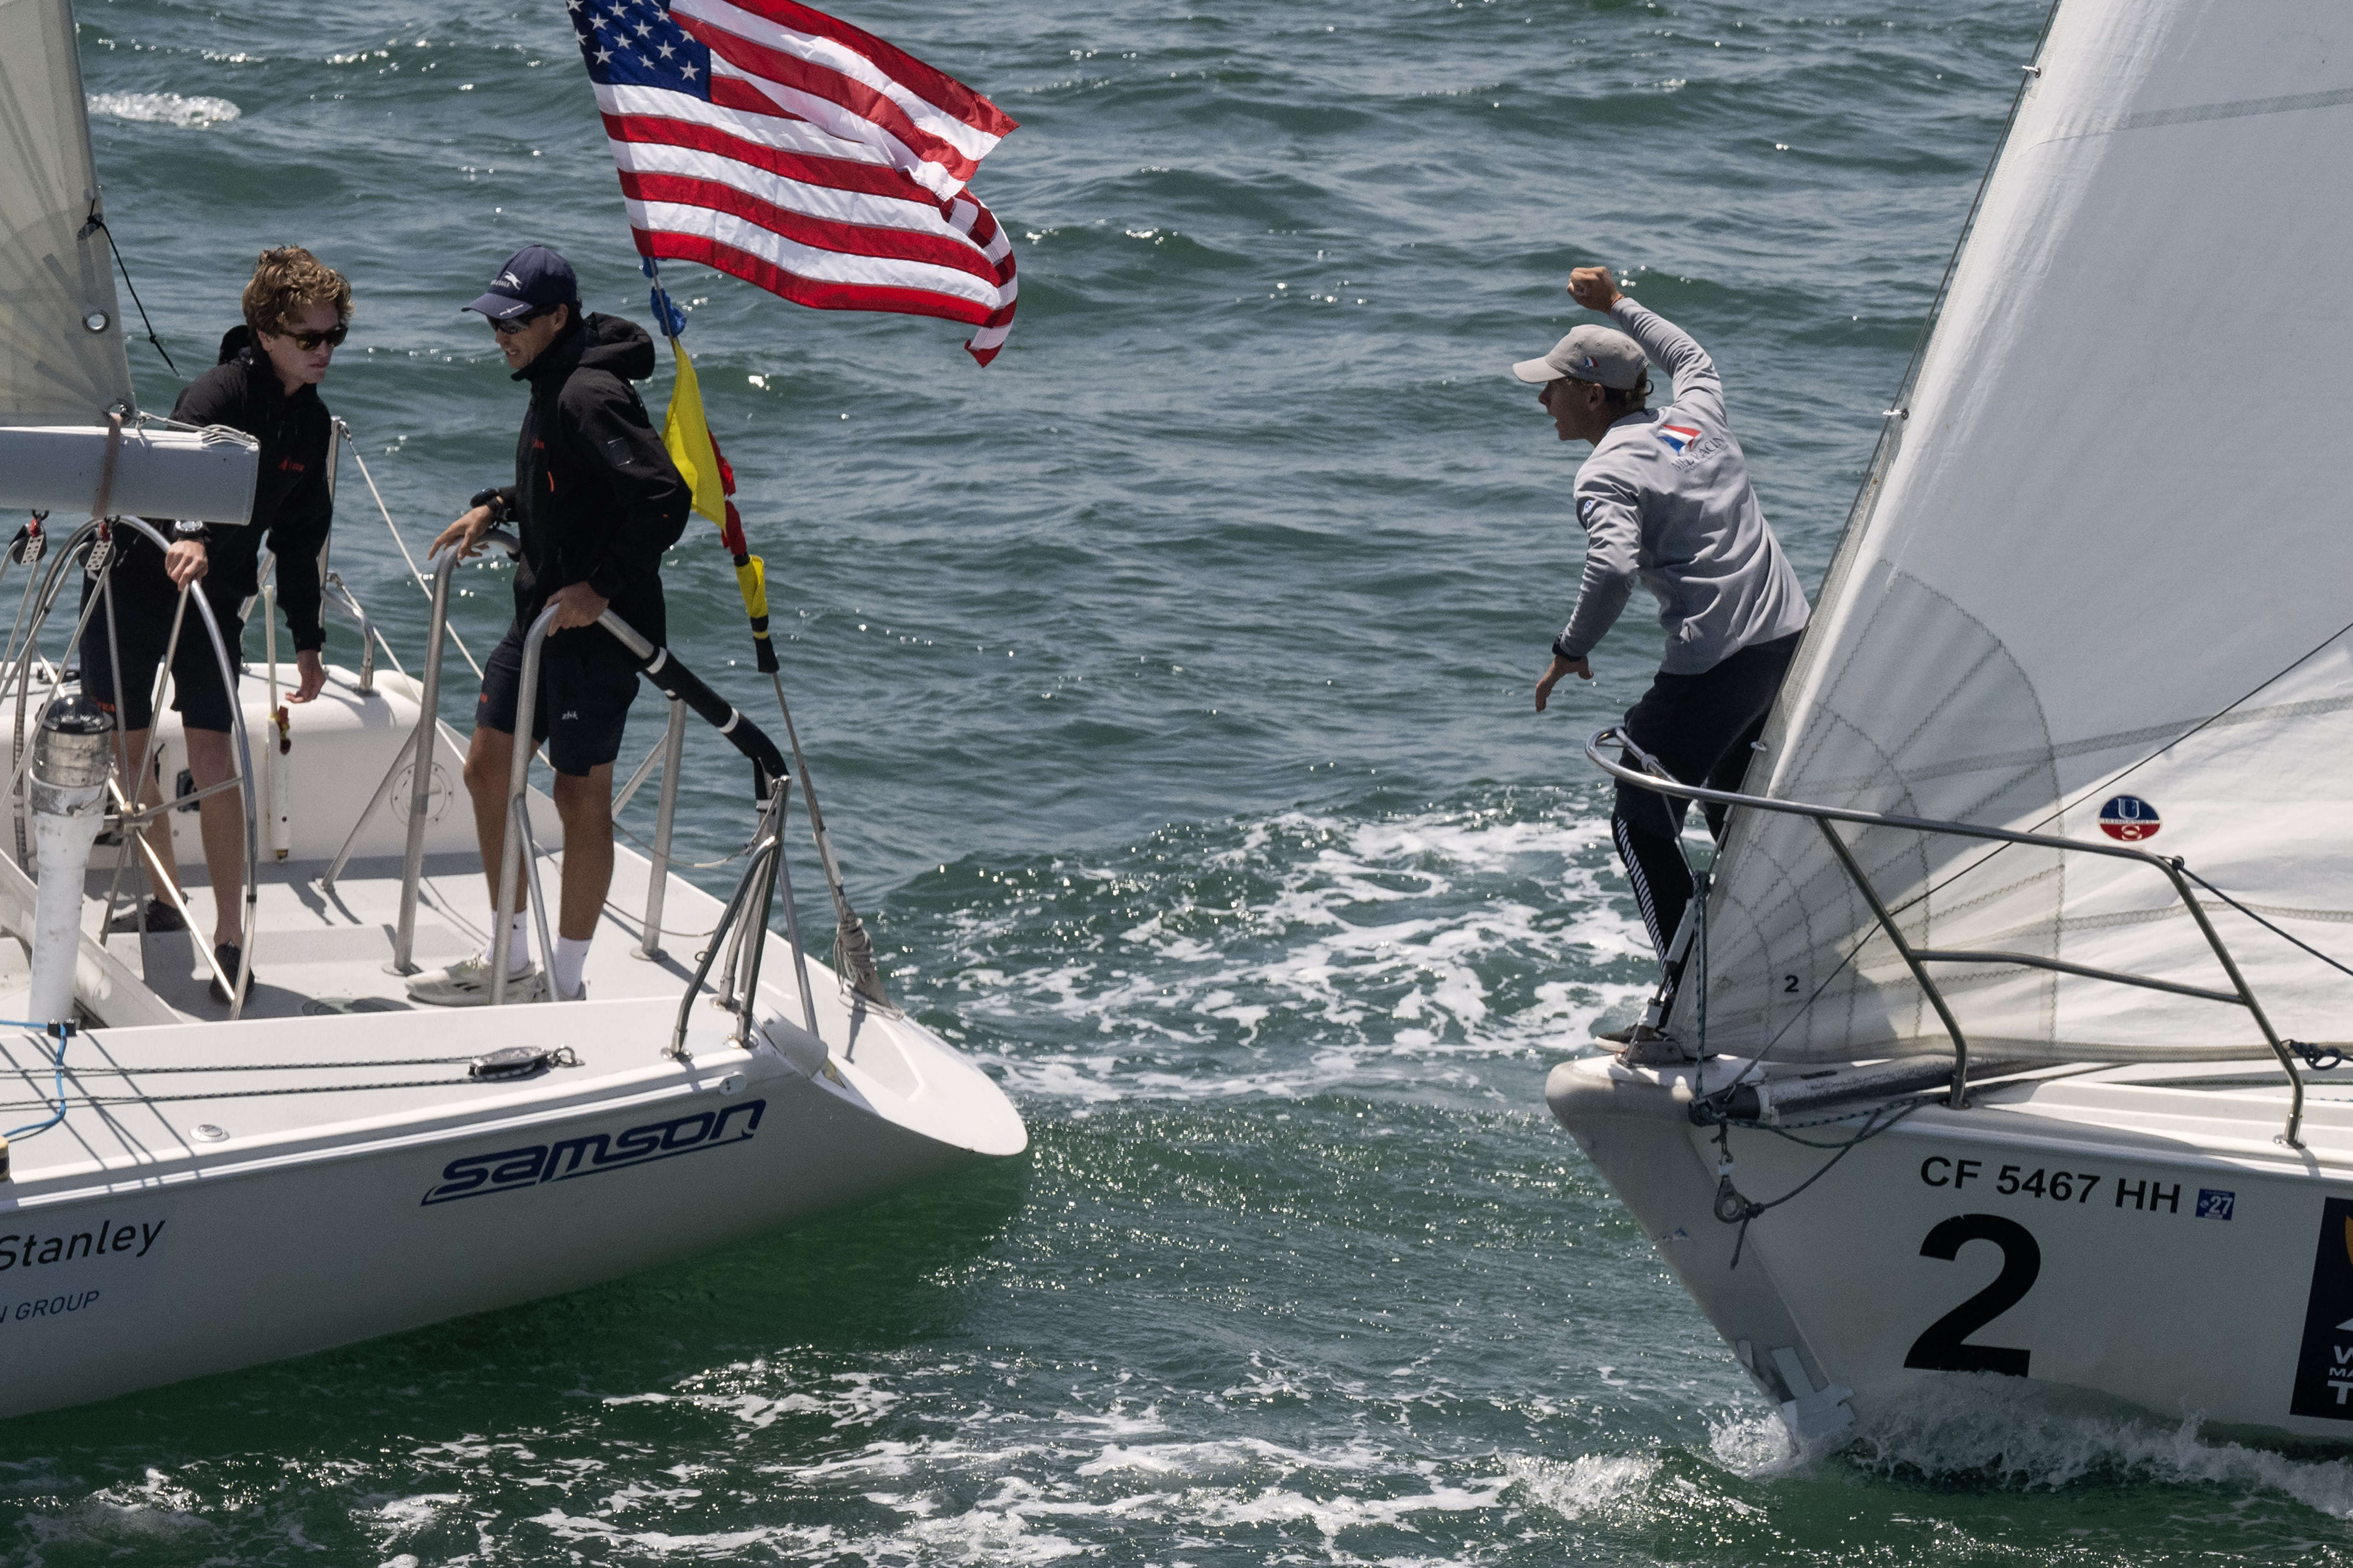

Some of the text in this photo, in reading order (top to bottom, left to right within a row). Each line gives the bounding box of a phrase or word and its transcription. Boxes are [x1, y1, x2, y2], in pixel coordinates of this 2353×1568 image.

[1784, 975, 1799, 992] 2
[1920, 1156, 2181, 1213] CF 5467 HH
[2209, 1196, 2233, 1215] 27
[0, 1220, 166, 1271] Stanley
[15, 1290, 100, 1321] GROUP
[1903, 1213, 2041, 1378] 2
